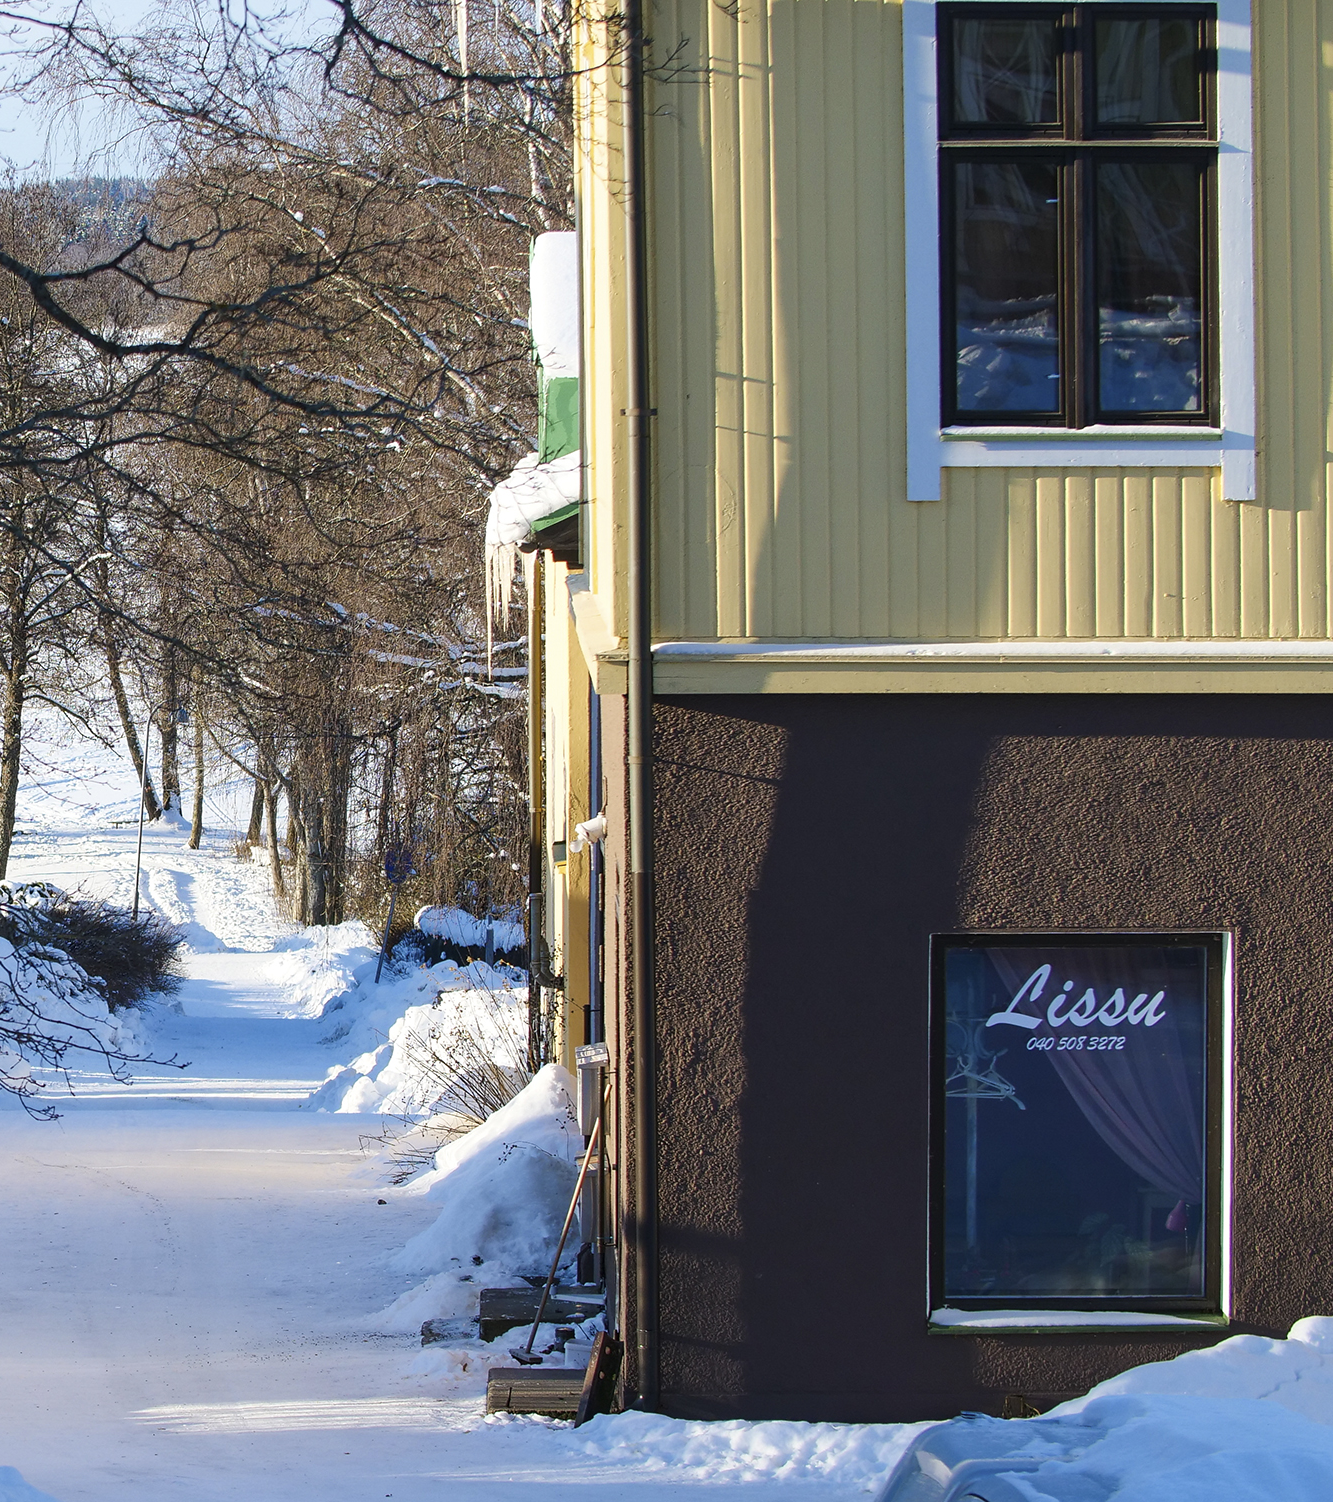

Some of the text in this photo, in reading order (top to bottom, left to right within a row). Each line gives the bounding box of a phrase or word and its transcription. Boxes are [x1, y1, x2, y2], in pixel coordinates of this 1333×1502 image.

[985, 963, 1166, 1029] Lissu
[1026, 1036, 1126, 1051] 040 508 3272
